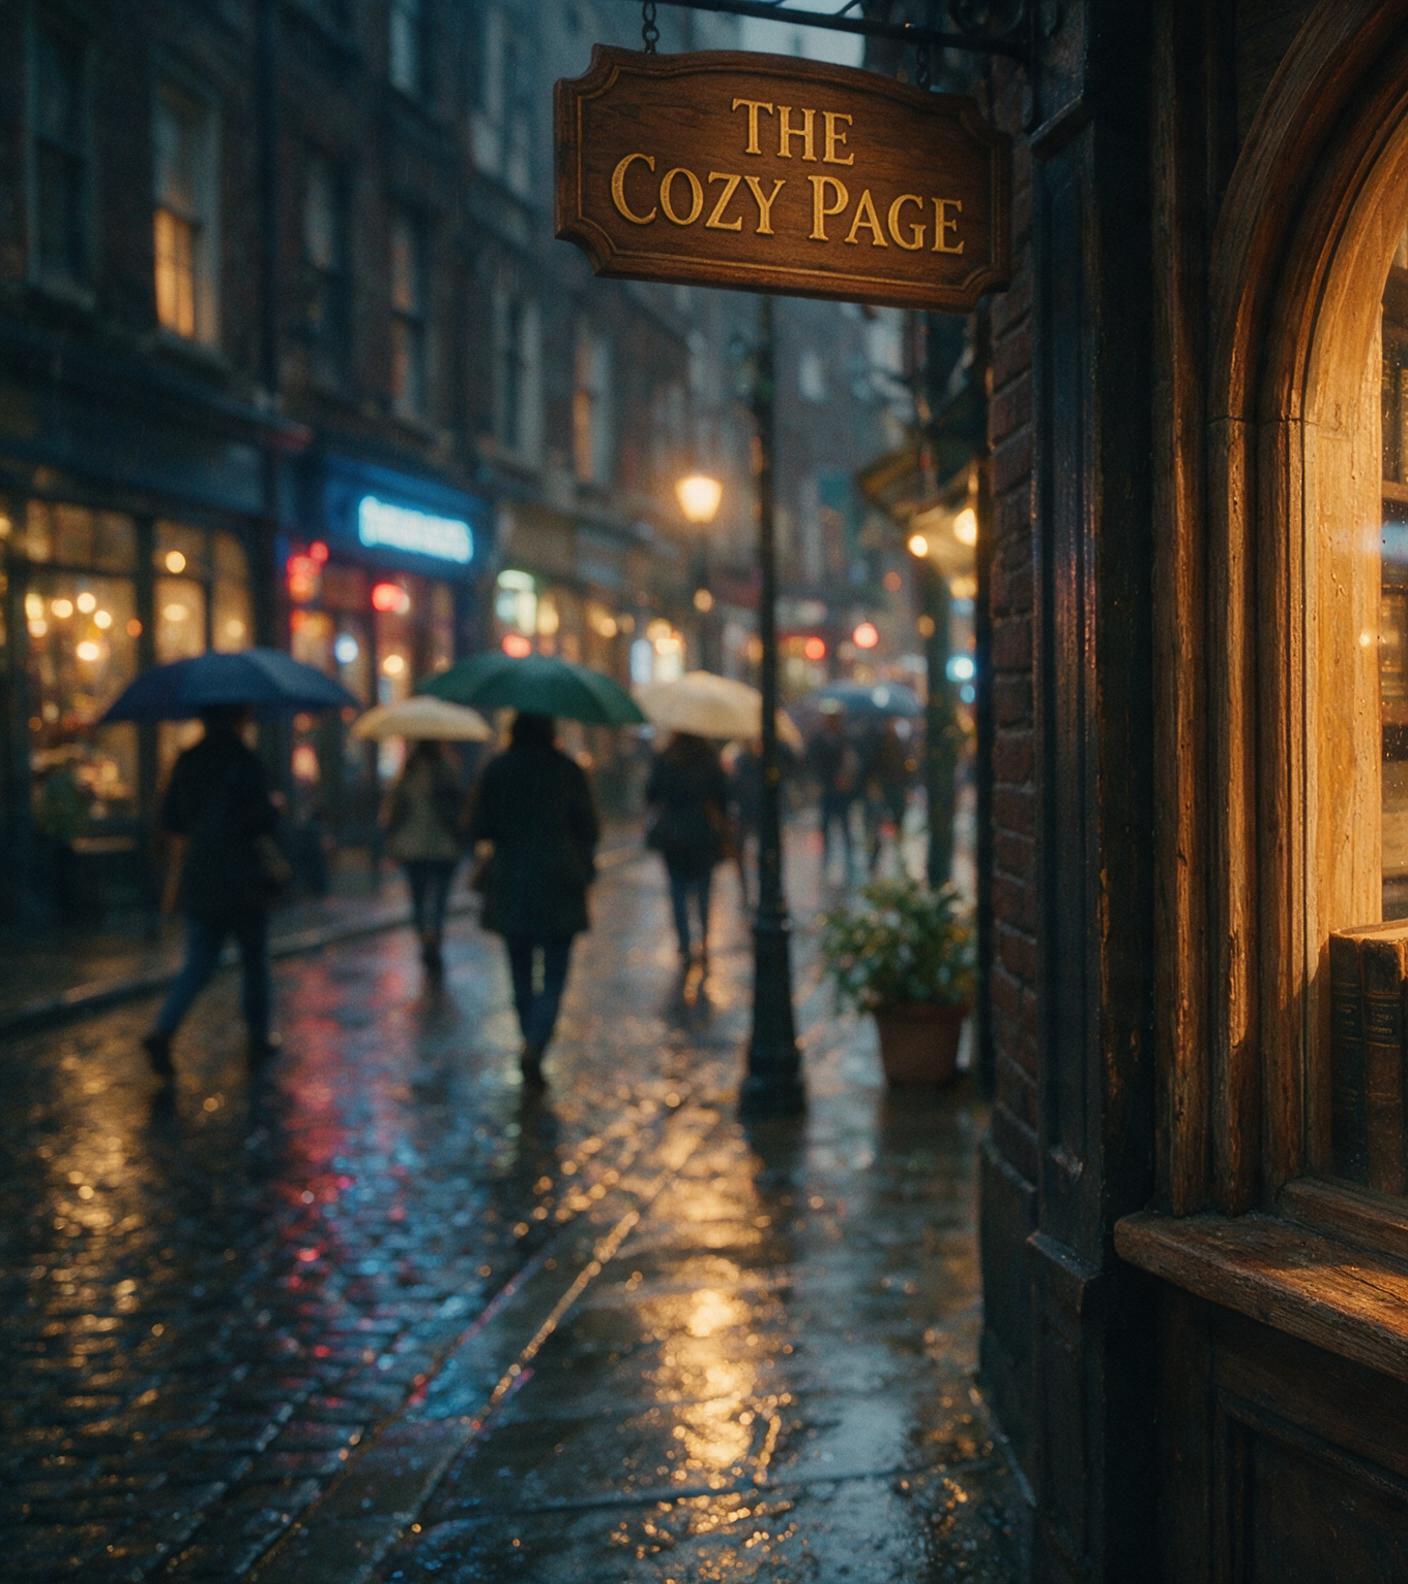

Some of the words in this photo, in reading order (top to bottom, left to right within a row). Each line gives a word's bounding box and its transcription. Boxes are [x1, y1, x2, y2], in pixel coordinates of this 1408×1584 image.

[732, 98, 855, 166] THE
[611, 153, 786, 235] COZY
[807, 175, 965, 254] PAGE
